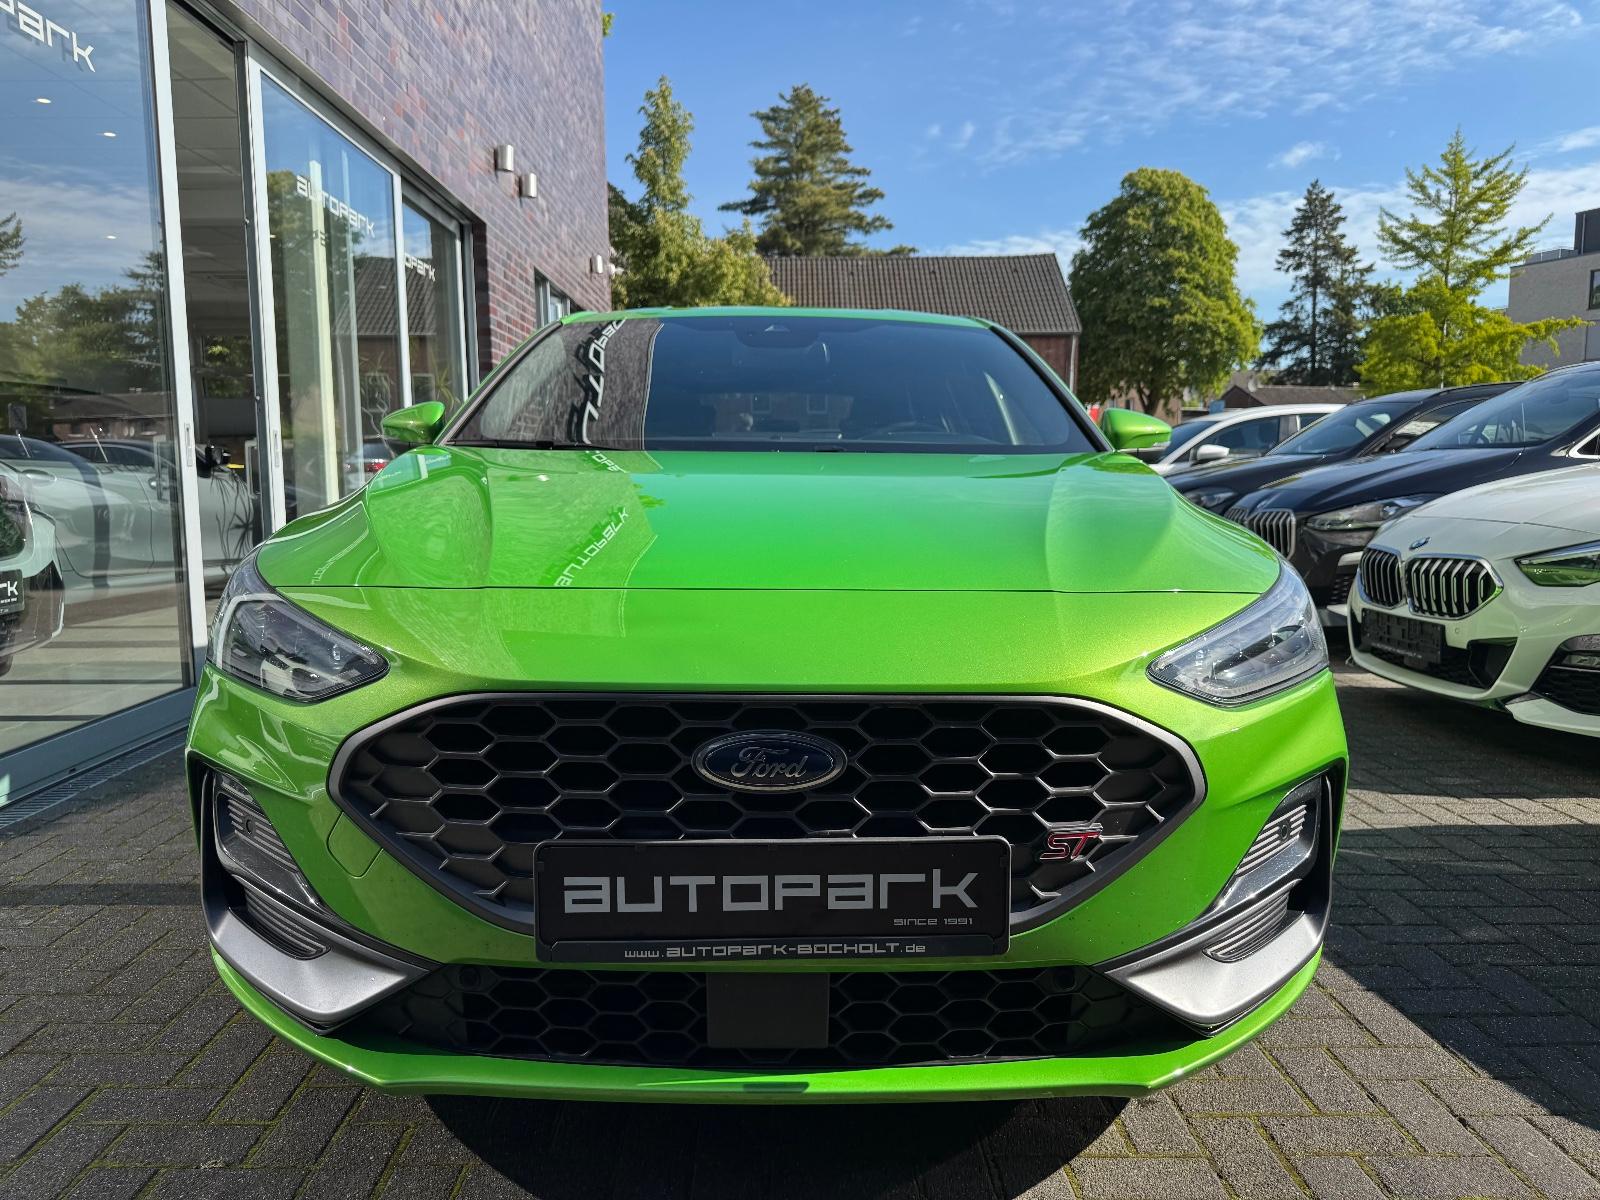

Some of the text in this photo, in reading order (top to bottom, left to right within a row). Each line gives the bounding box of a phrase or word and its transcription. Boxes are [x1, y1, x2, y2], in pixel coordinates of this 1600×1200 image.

[731, 747, 809, 778] Ford
[1039, 831, 1101, 860] ST
[943, 917, 973, 925] 1991
